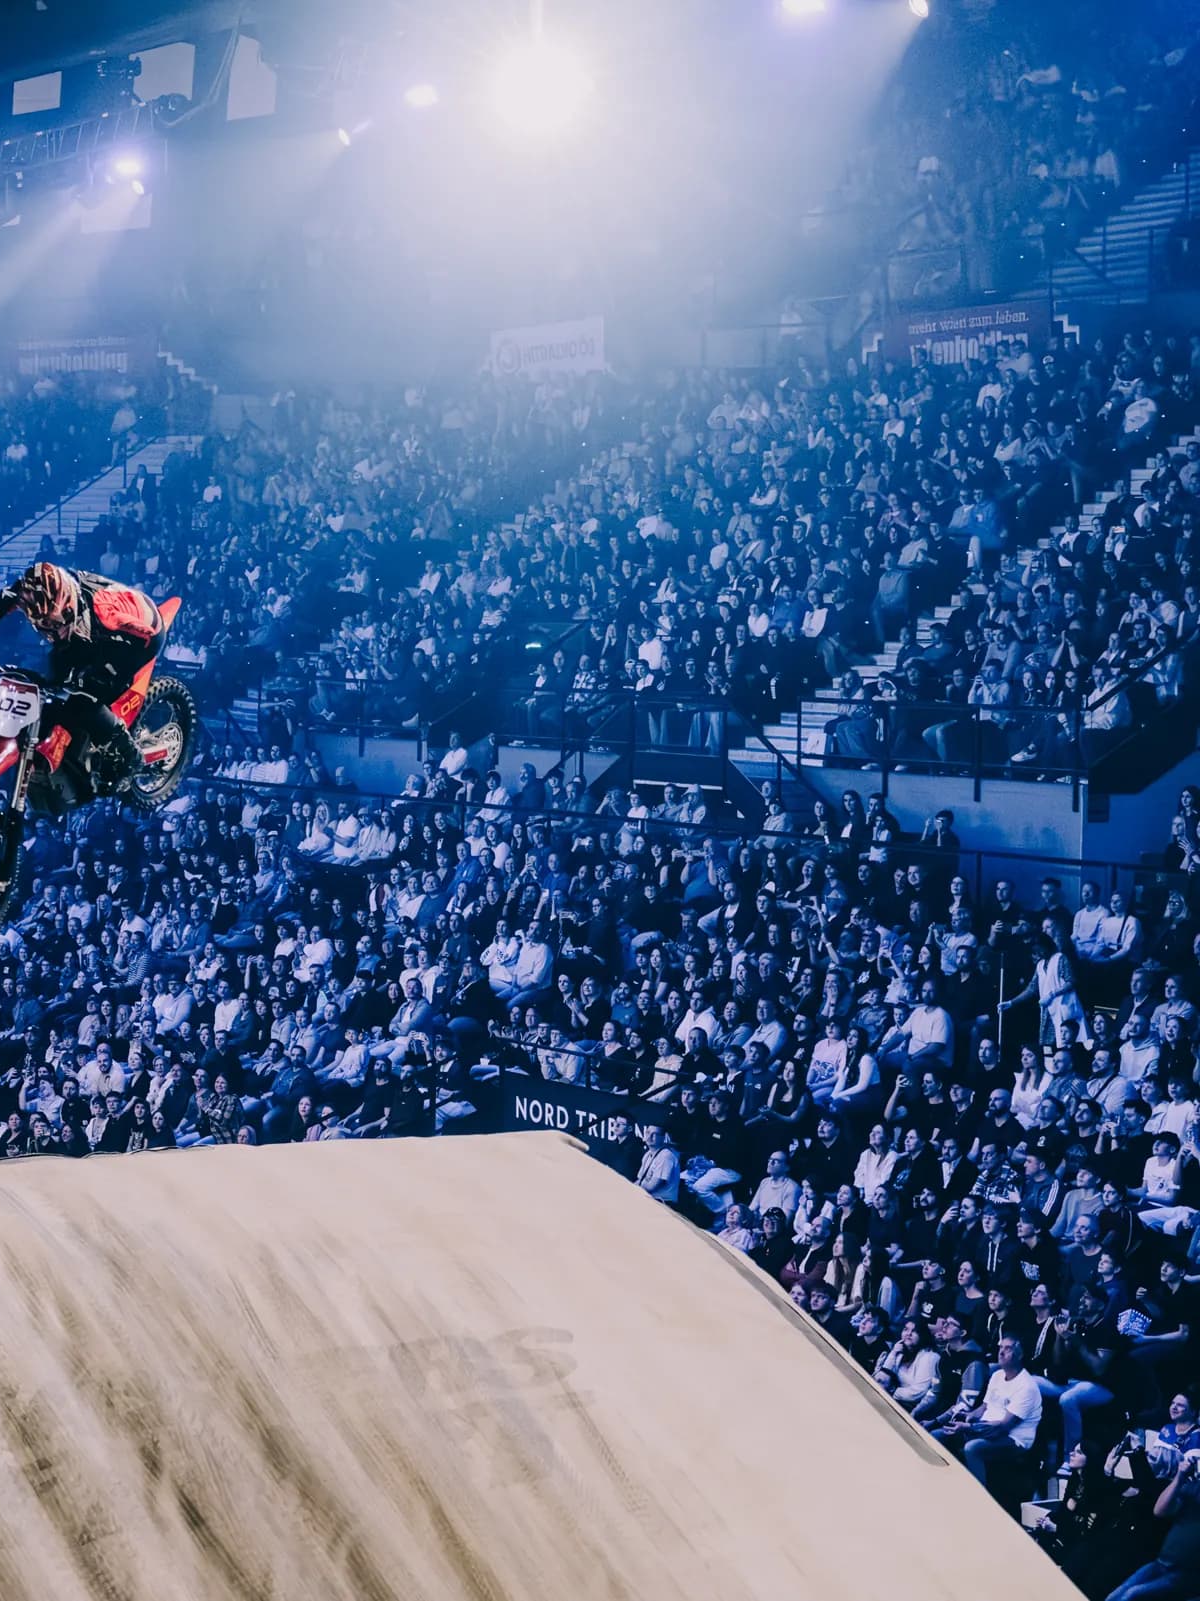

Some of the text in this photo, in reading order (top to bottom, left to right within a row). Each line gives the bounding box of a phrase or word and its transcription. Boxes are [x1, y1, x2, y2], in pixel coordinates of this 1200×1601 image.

[908, 319, 937, 335] mehr
[967, 315, 993, 328] zum
[121, 695, 140, 716] 02
[515, 1096, 569, 1129] NORD
